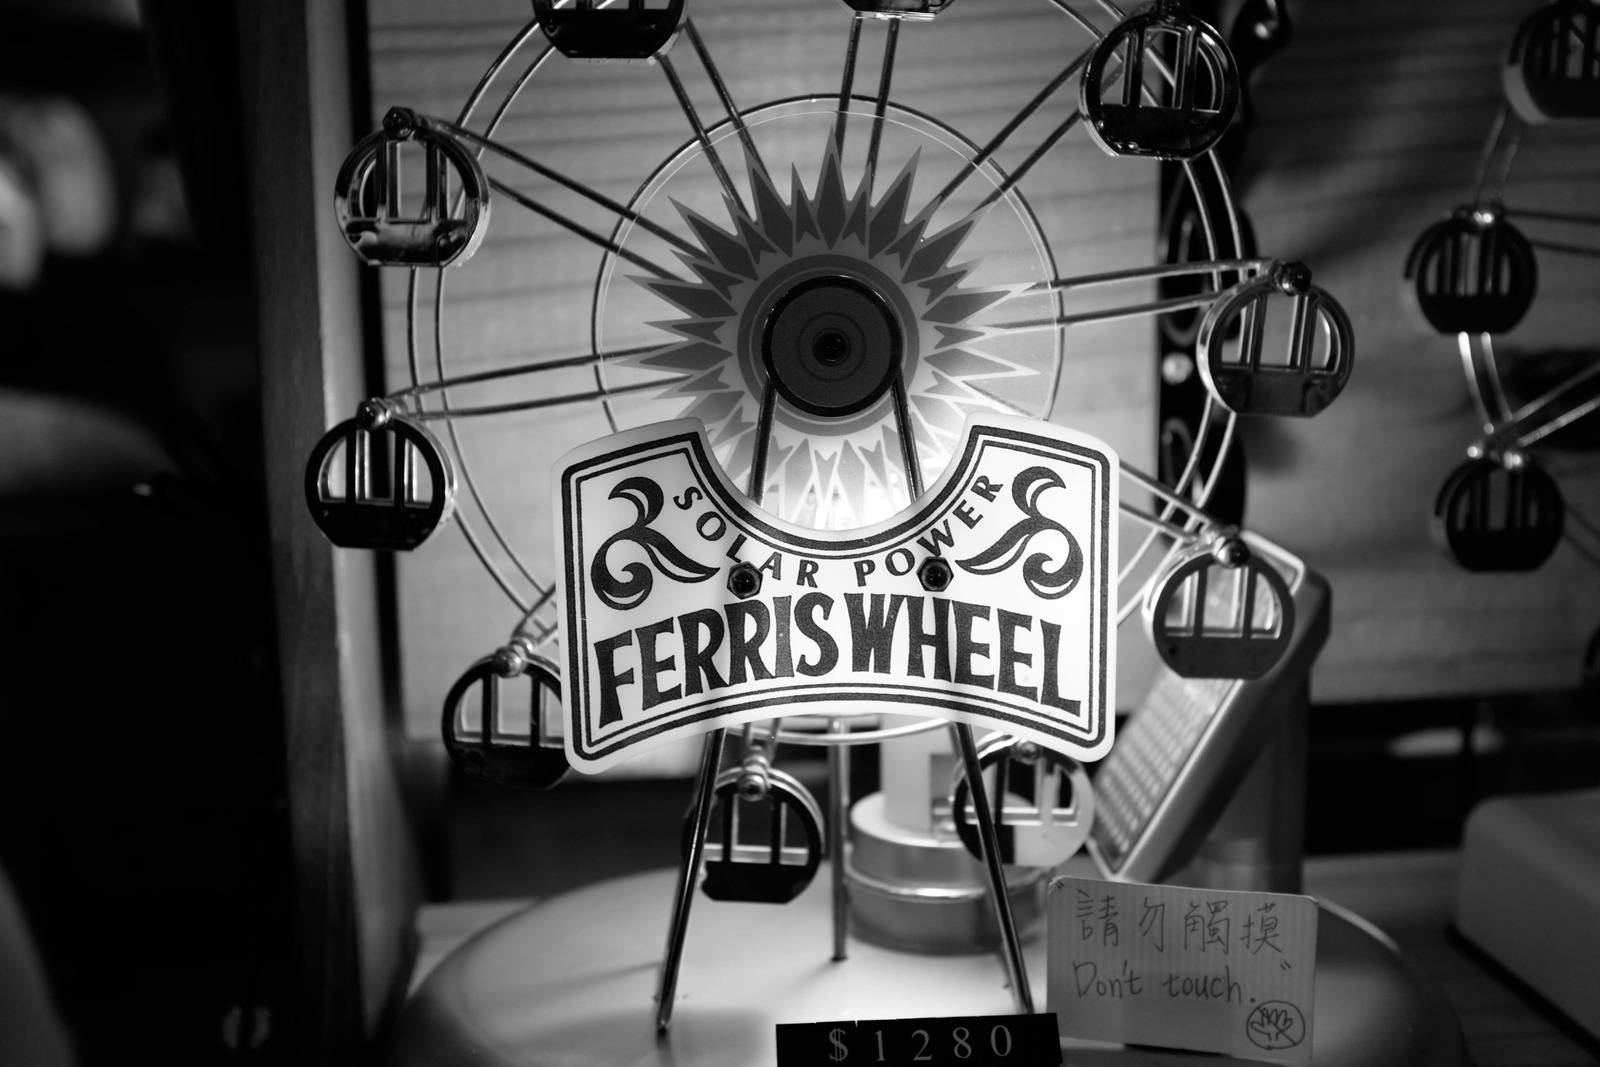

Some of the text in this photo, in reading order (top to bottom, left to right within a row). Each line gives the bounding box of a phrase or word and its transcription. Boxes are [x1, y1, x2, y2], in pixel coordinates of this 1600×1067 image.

[673, 474, 1004, 588] SOLAR POWER
[594, 592, 1081, 729] FERRIS WHEEL
[1072, 960, 1142, 1000] Don't
[828, 1025, 1013, 1063] $1280
